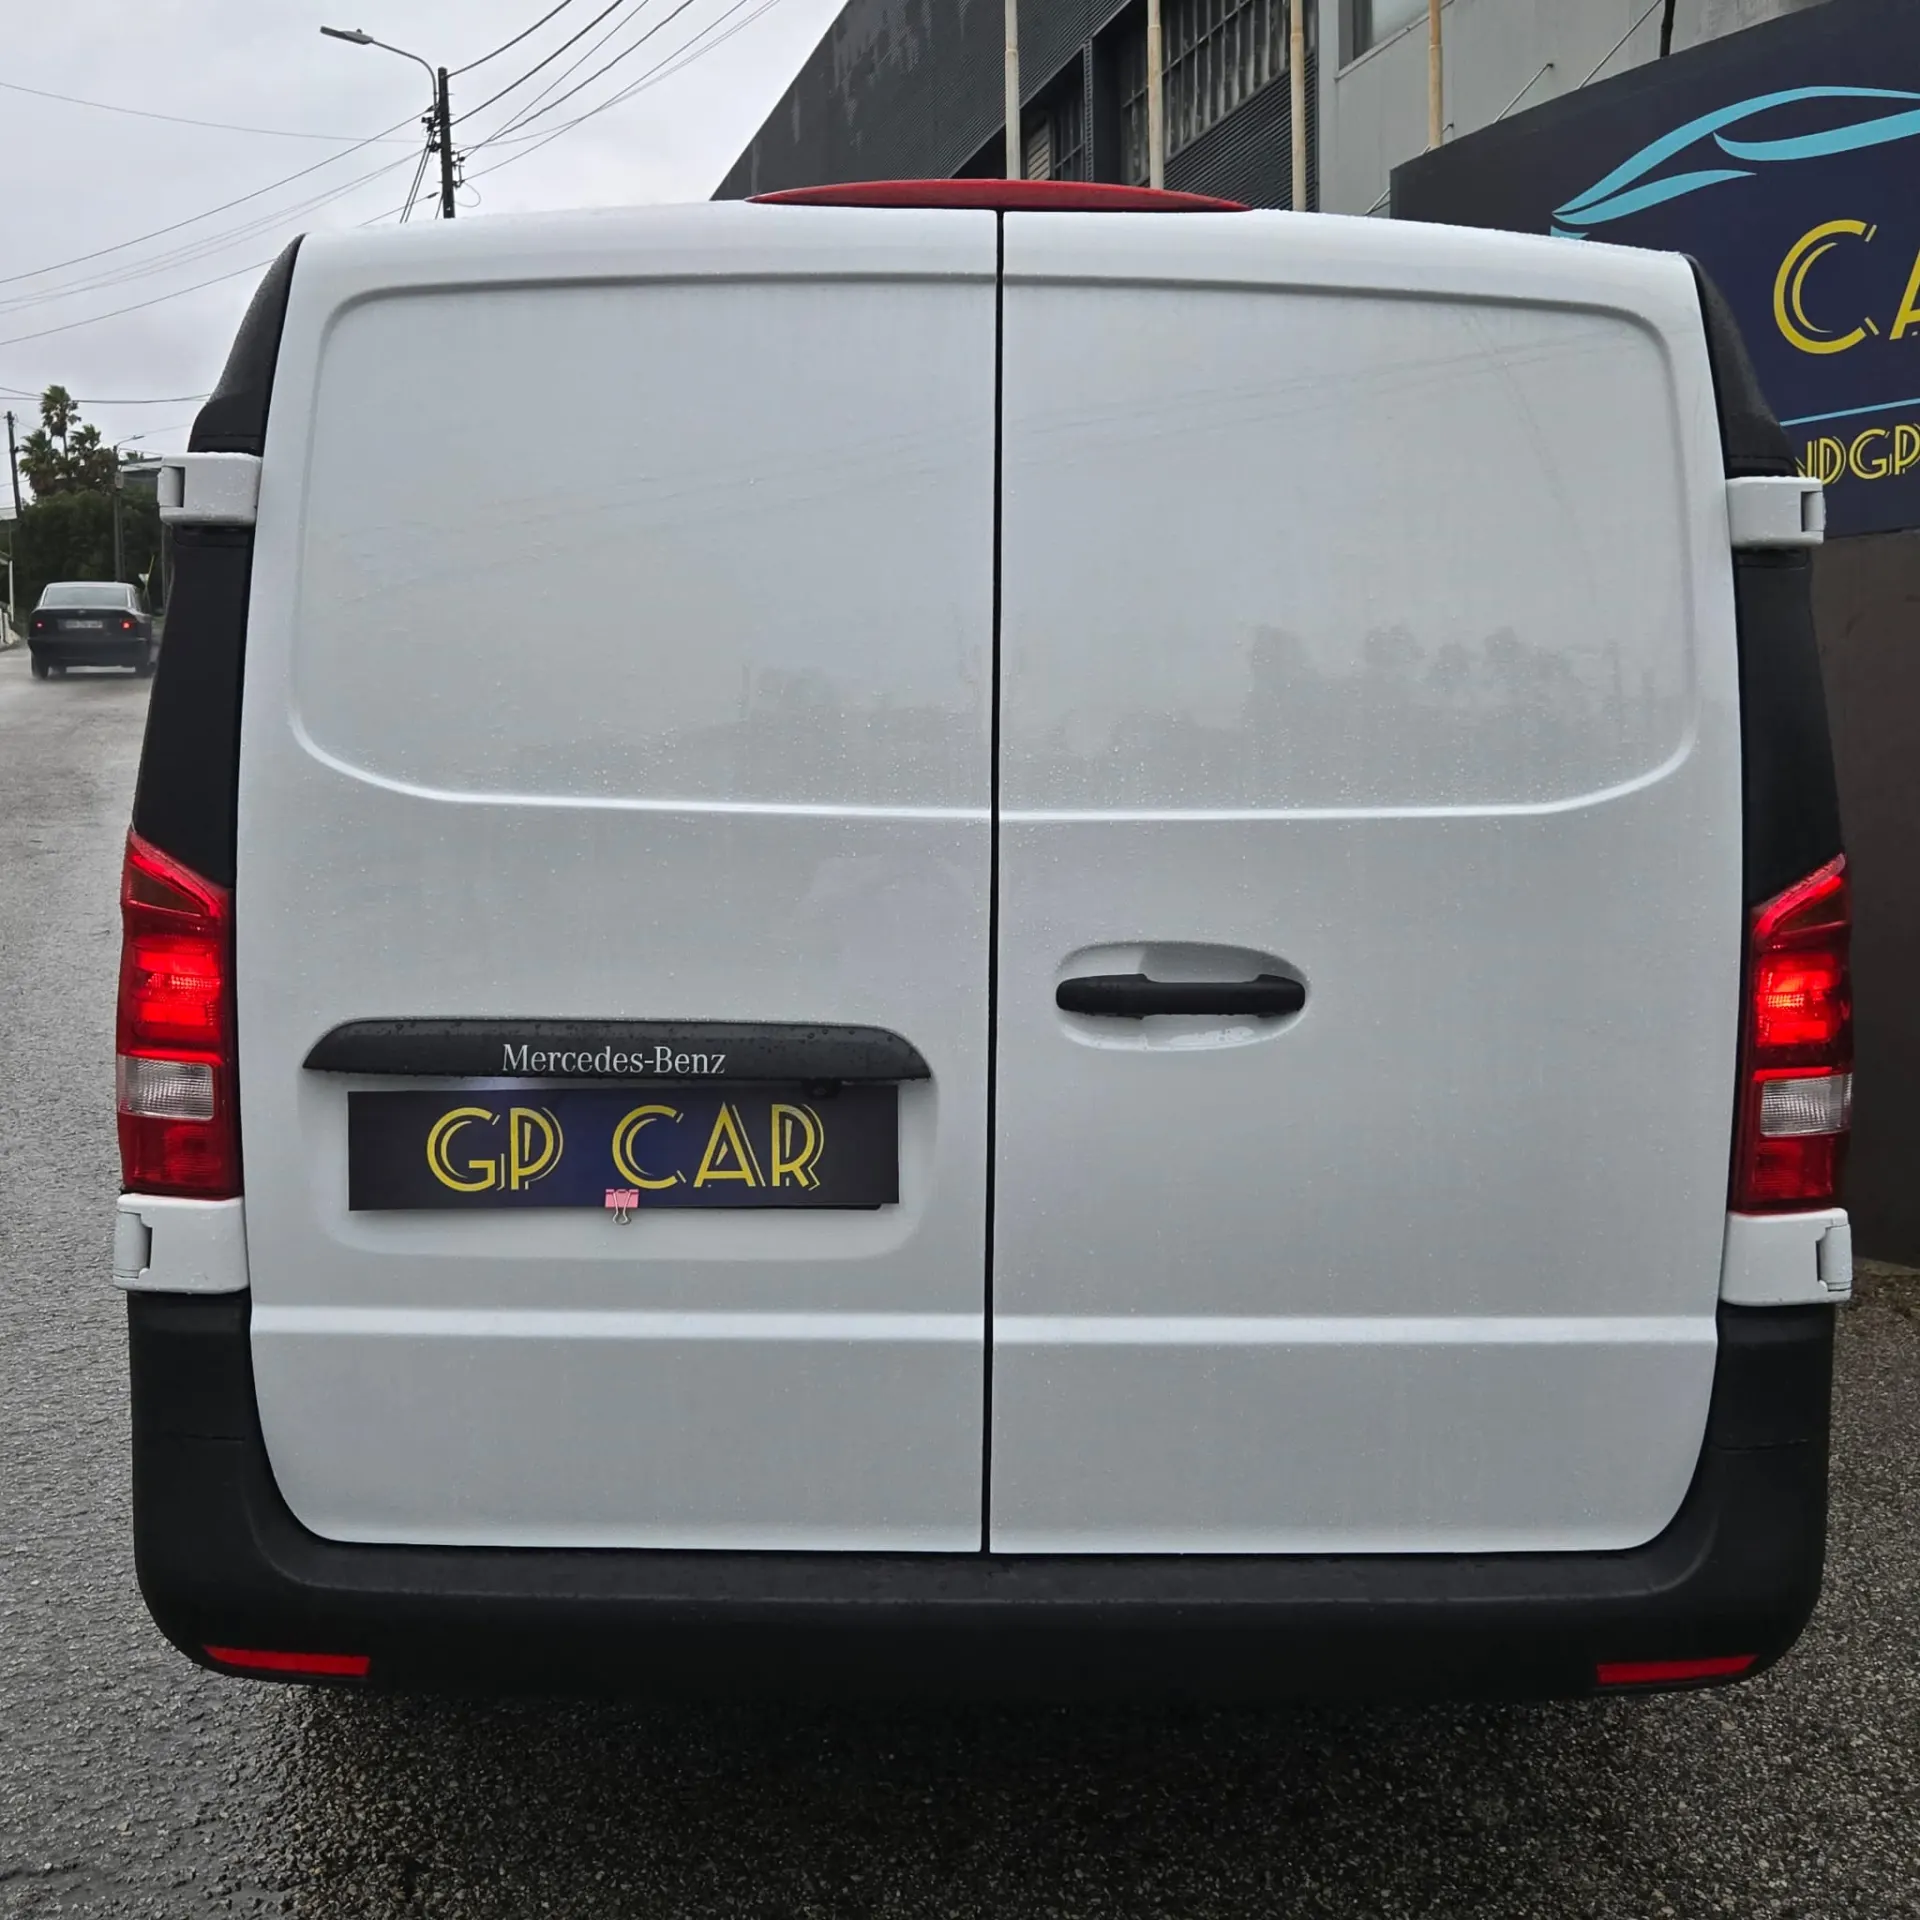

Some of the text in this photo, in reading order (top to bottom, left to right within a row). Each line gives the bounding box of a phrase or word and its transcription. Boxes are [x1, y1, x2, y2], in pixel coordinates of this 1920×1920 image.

[502, 1043, 726, 1074] Mercedes-Benz
[426, 1101, 824, 1192] GP CAR
